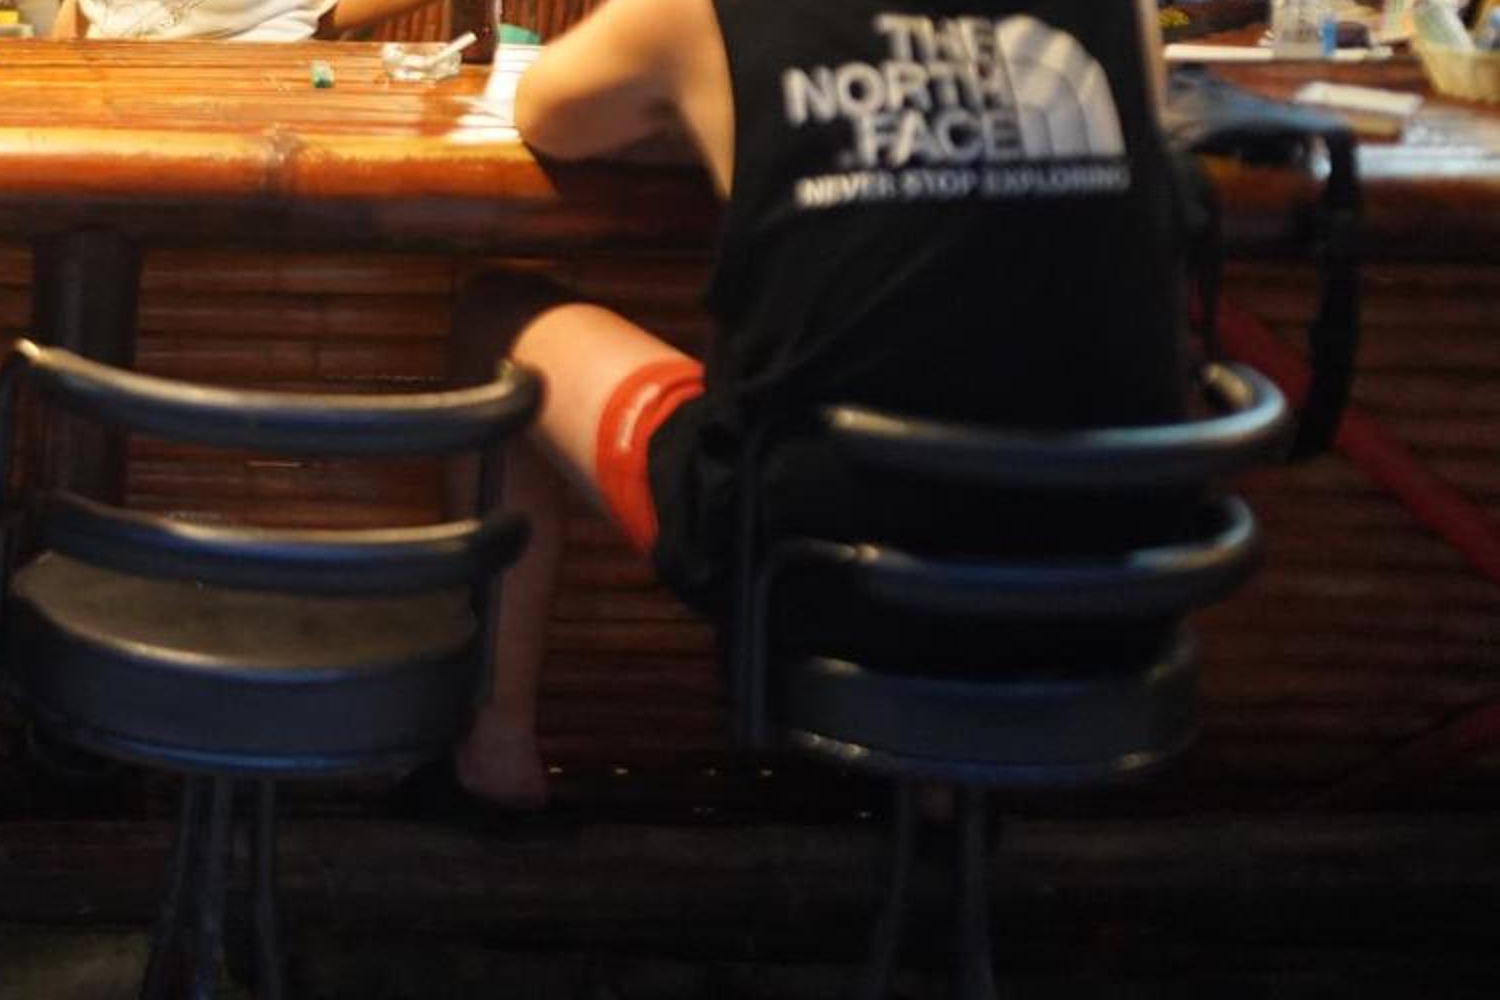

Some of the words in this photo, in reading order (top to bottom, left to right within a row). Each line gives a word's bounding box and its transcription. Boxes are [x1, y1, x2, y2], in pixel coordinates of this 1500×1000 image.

[874, 14, 998, 62] THE
[784, 62, 1014, 124] NORTH
[854, 106, 1022, 167] FACE
[795, 171, 895, 209] NEVER
[902, 168, 978, 199] STOP
[984, 165, 1131, 198] EXPLORING
